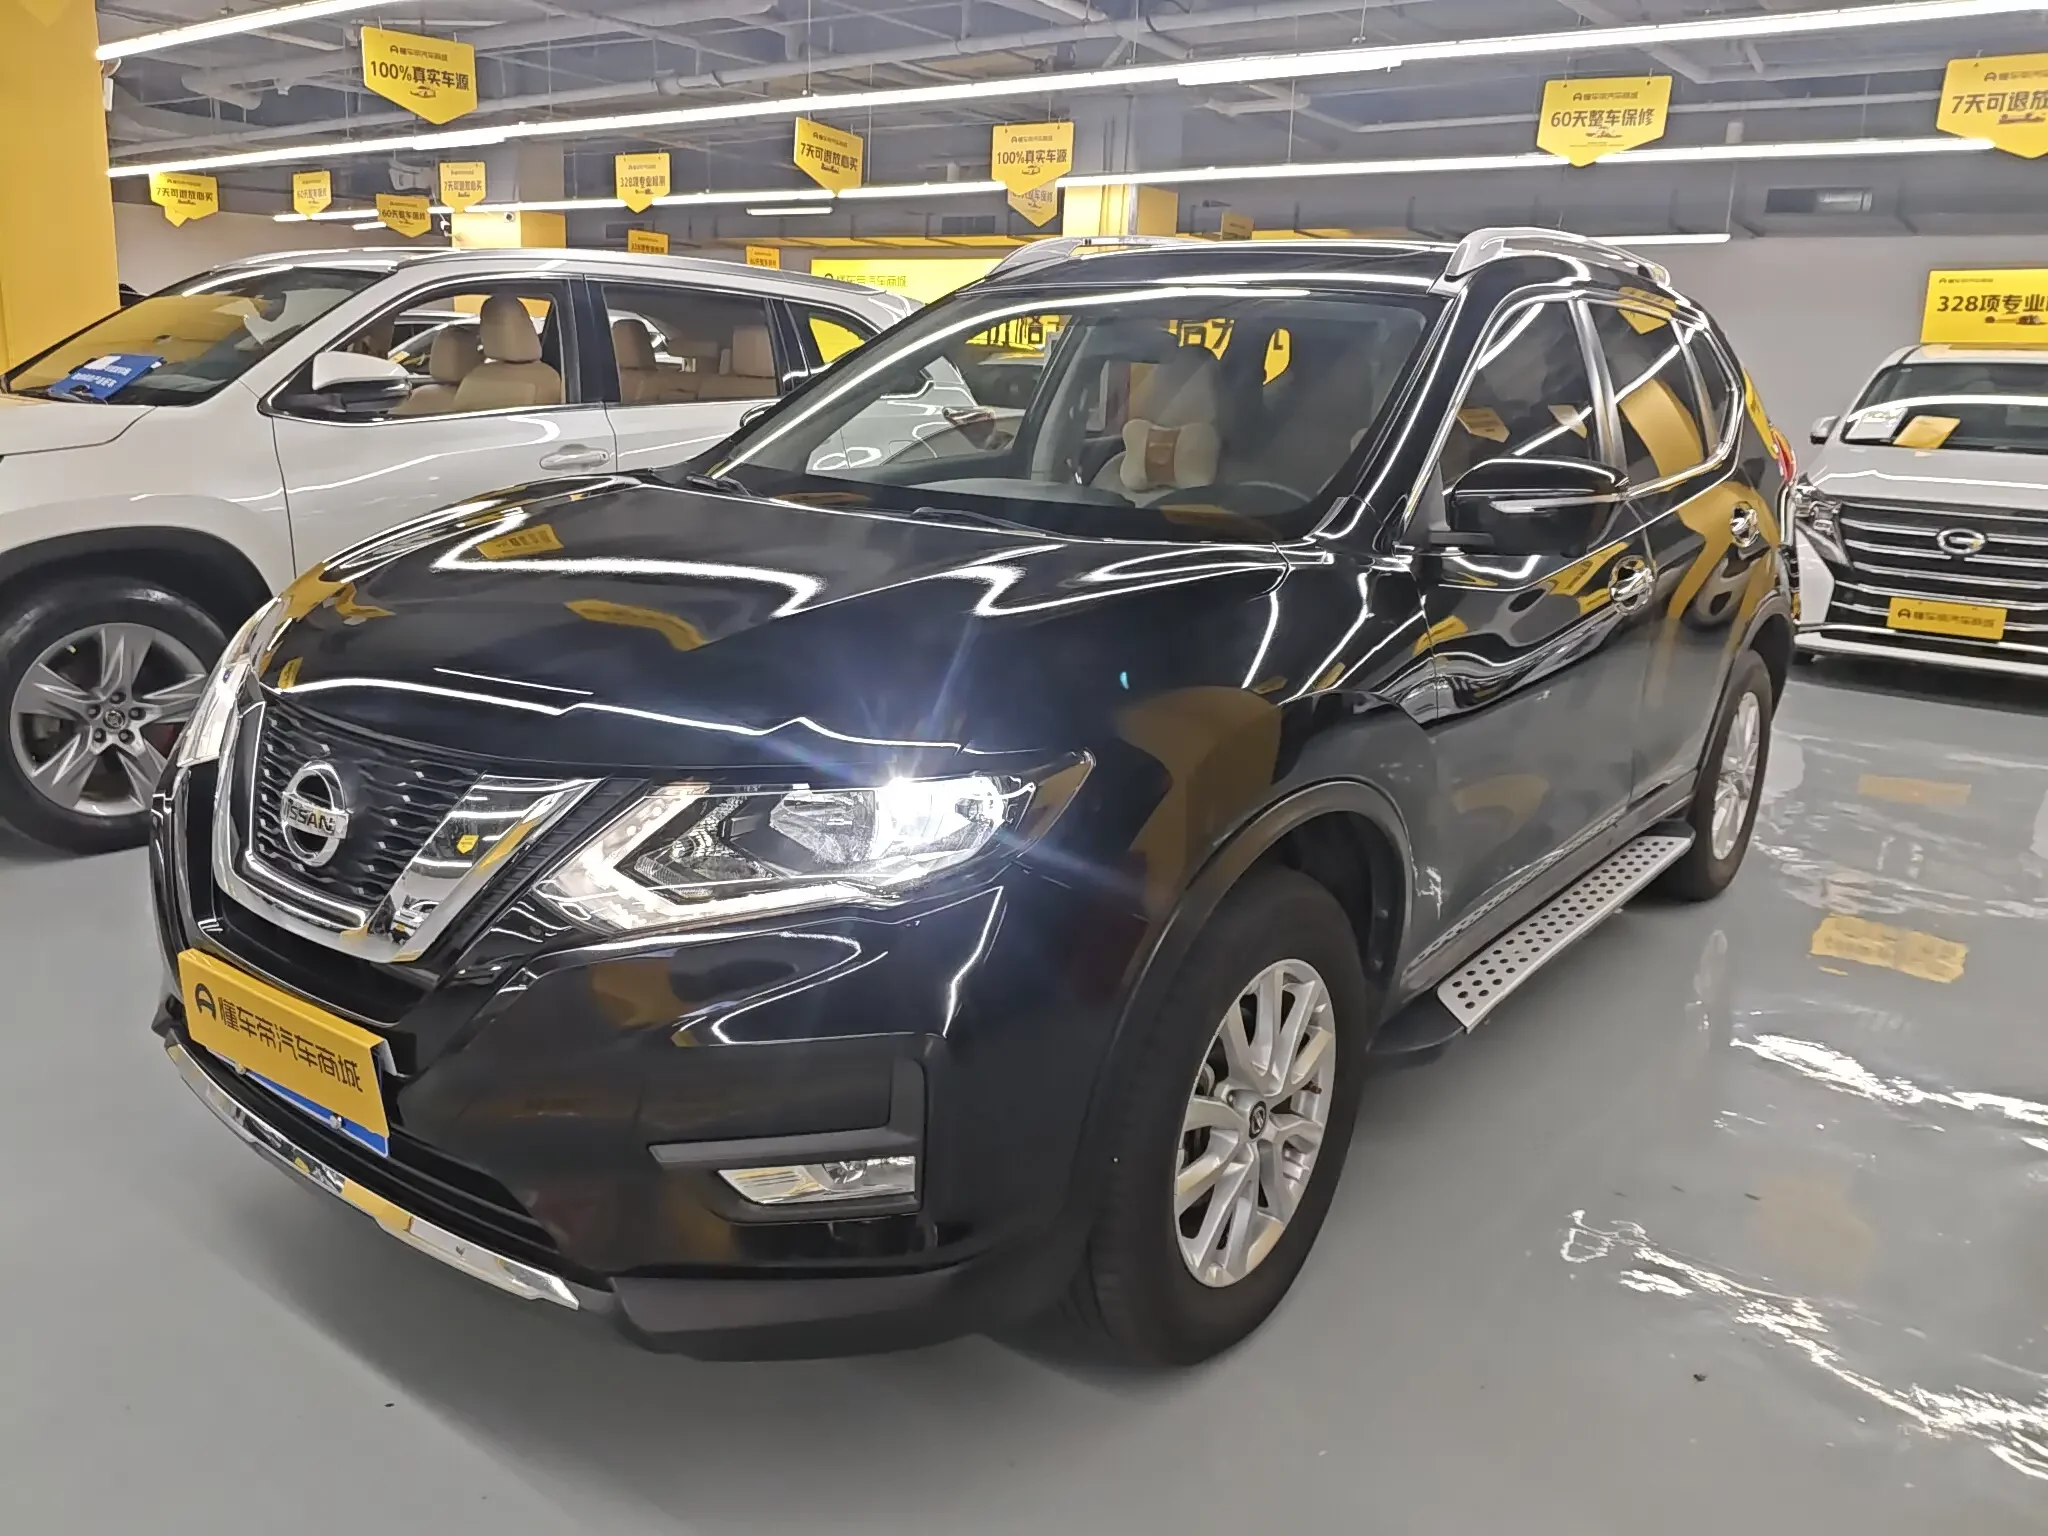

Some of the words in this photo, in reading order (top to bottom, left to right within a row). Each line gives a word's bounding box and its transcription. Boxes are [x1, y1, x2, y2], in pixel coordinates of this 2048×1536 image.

[370, 61, 470, 91] 100%真实车源
[1550, 108, 1656, 128] 60天整车保修
[997, 149, 1068, 165] 100%真实车源
[1937, 294, 2048, 314] 328项专业
[218, 996, 364, 1093] 懂车帝汽车商城
